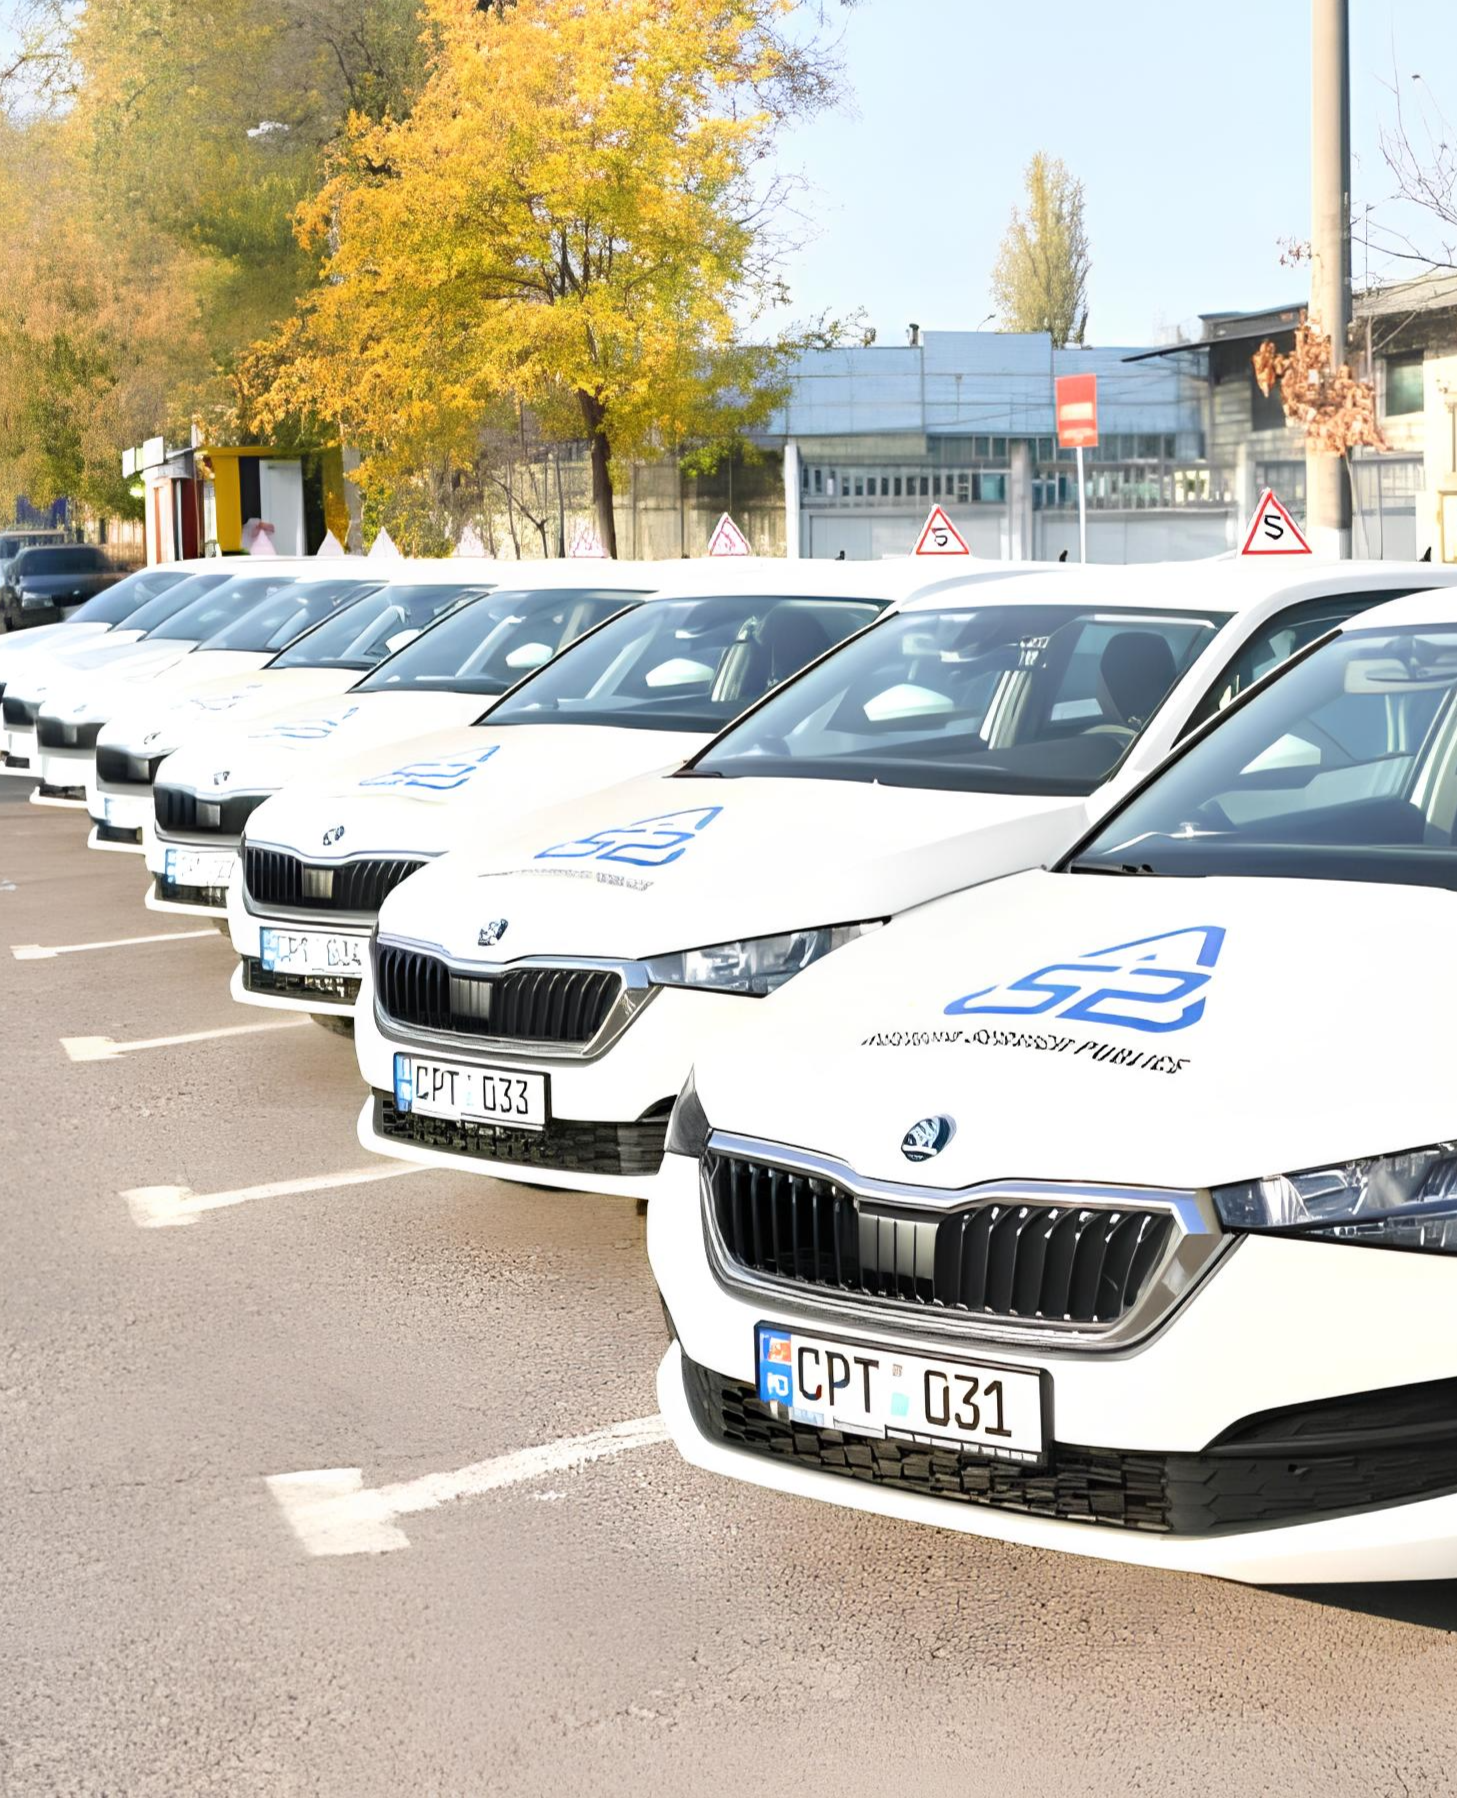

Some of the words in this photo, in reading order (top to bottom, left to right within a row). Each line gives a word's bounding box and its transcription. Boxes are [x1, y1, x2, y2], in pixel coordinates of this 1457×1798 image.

[416, 1065, 460, 1106] CPT
[483, 1076, 529, 1115] 033
[797, 1346, 880, 1414] CPT
[924, 1369, 1013, 1438] 031
